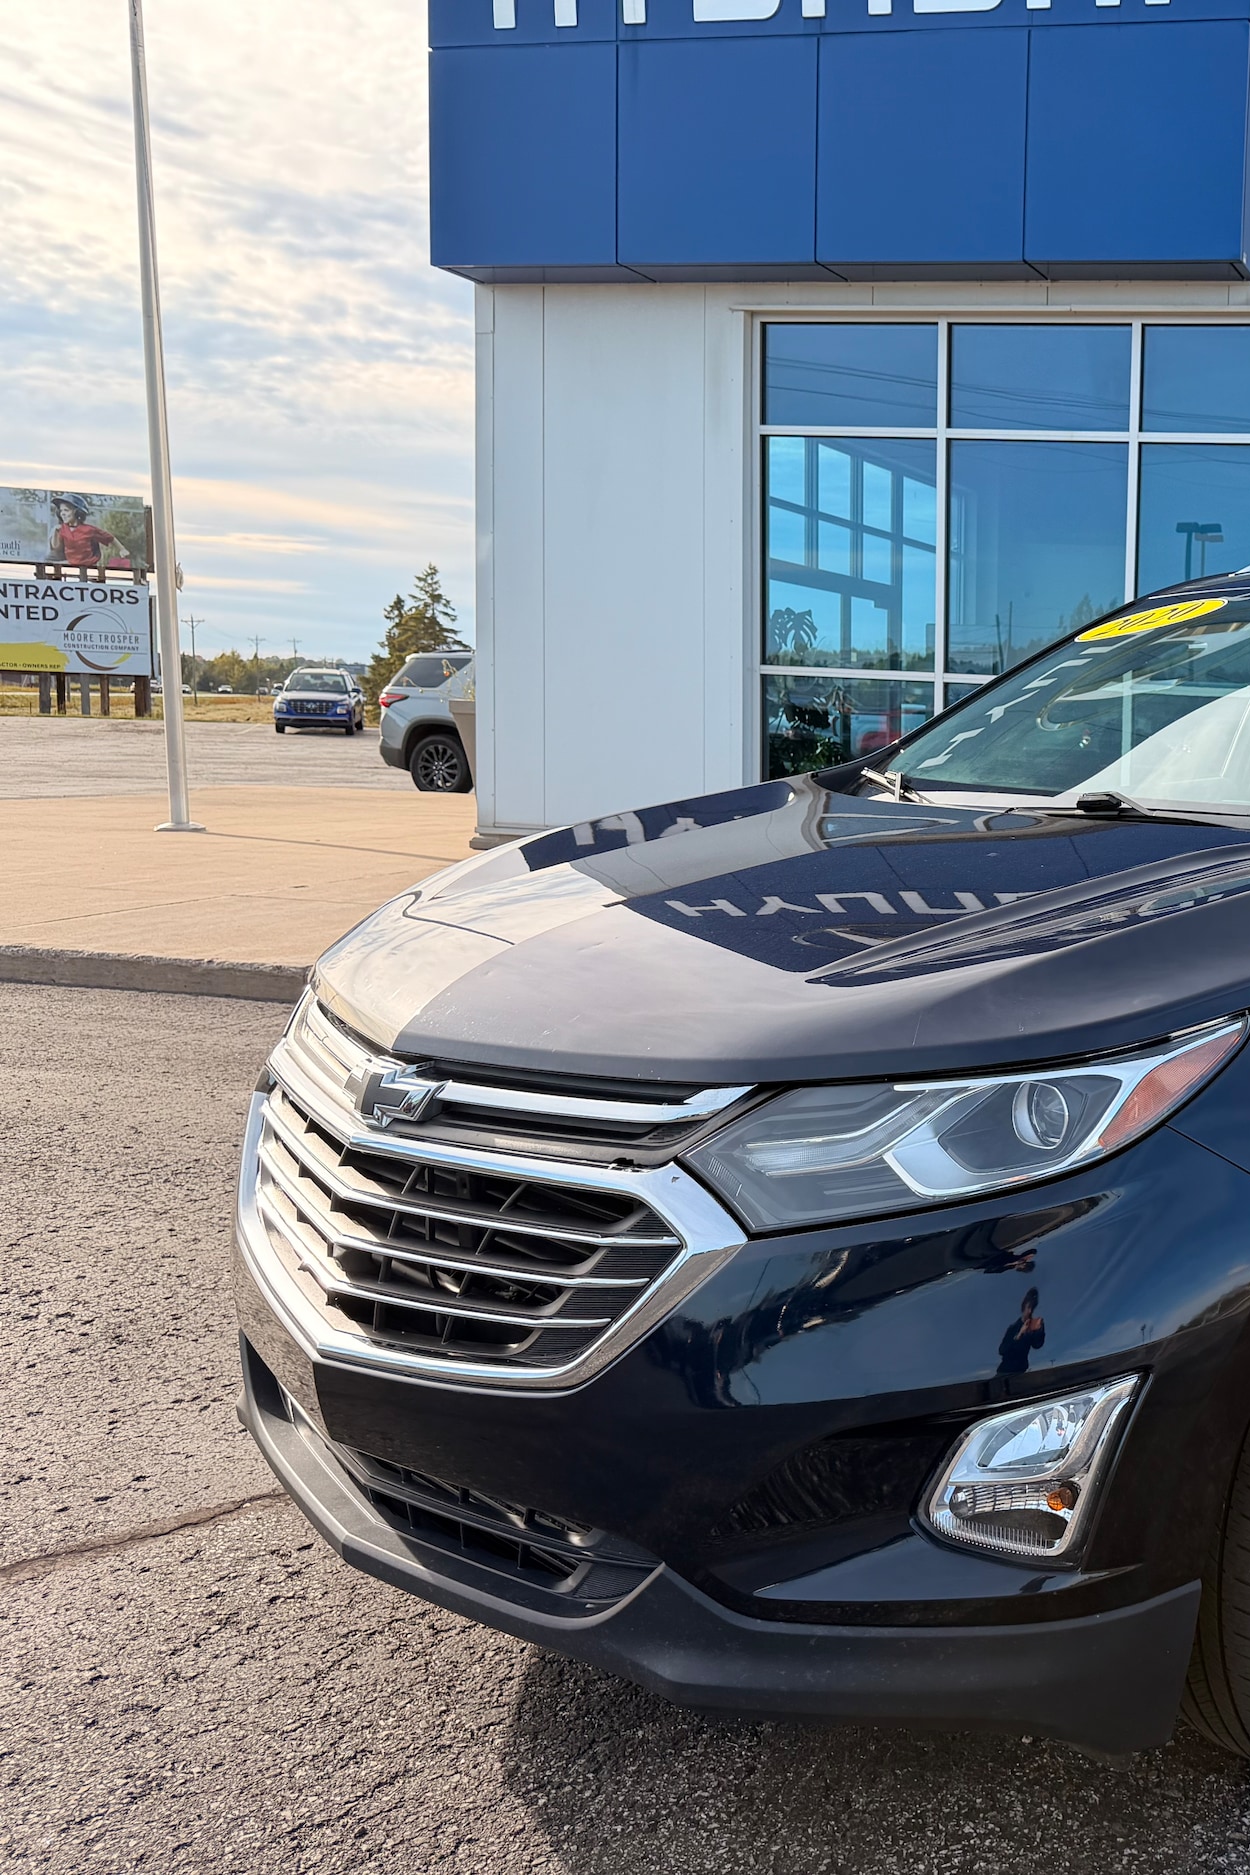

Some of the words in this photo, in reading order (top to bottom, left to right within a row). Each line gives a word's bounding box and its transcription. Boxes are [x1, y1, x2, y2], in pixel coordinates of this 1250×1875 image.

[1090, 601, 1206, 638] 2020
[63, 632, 95, 642] MOORE
[98, 634, 140, 644] TROSPER
